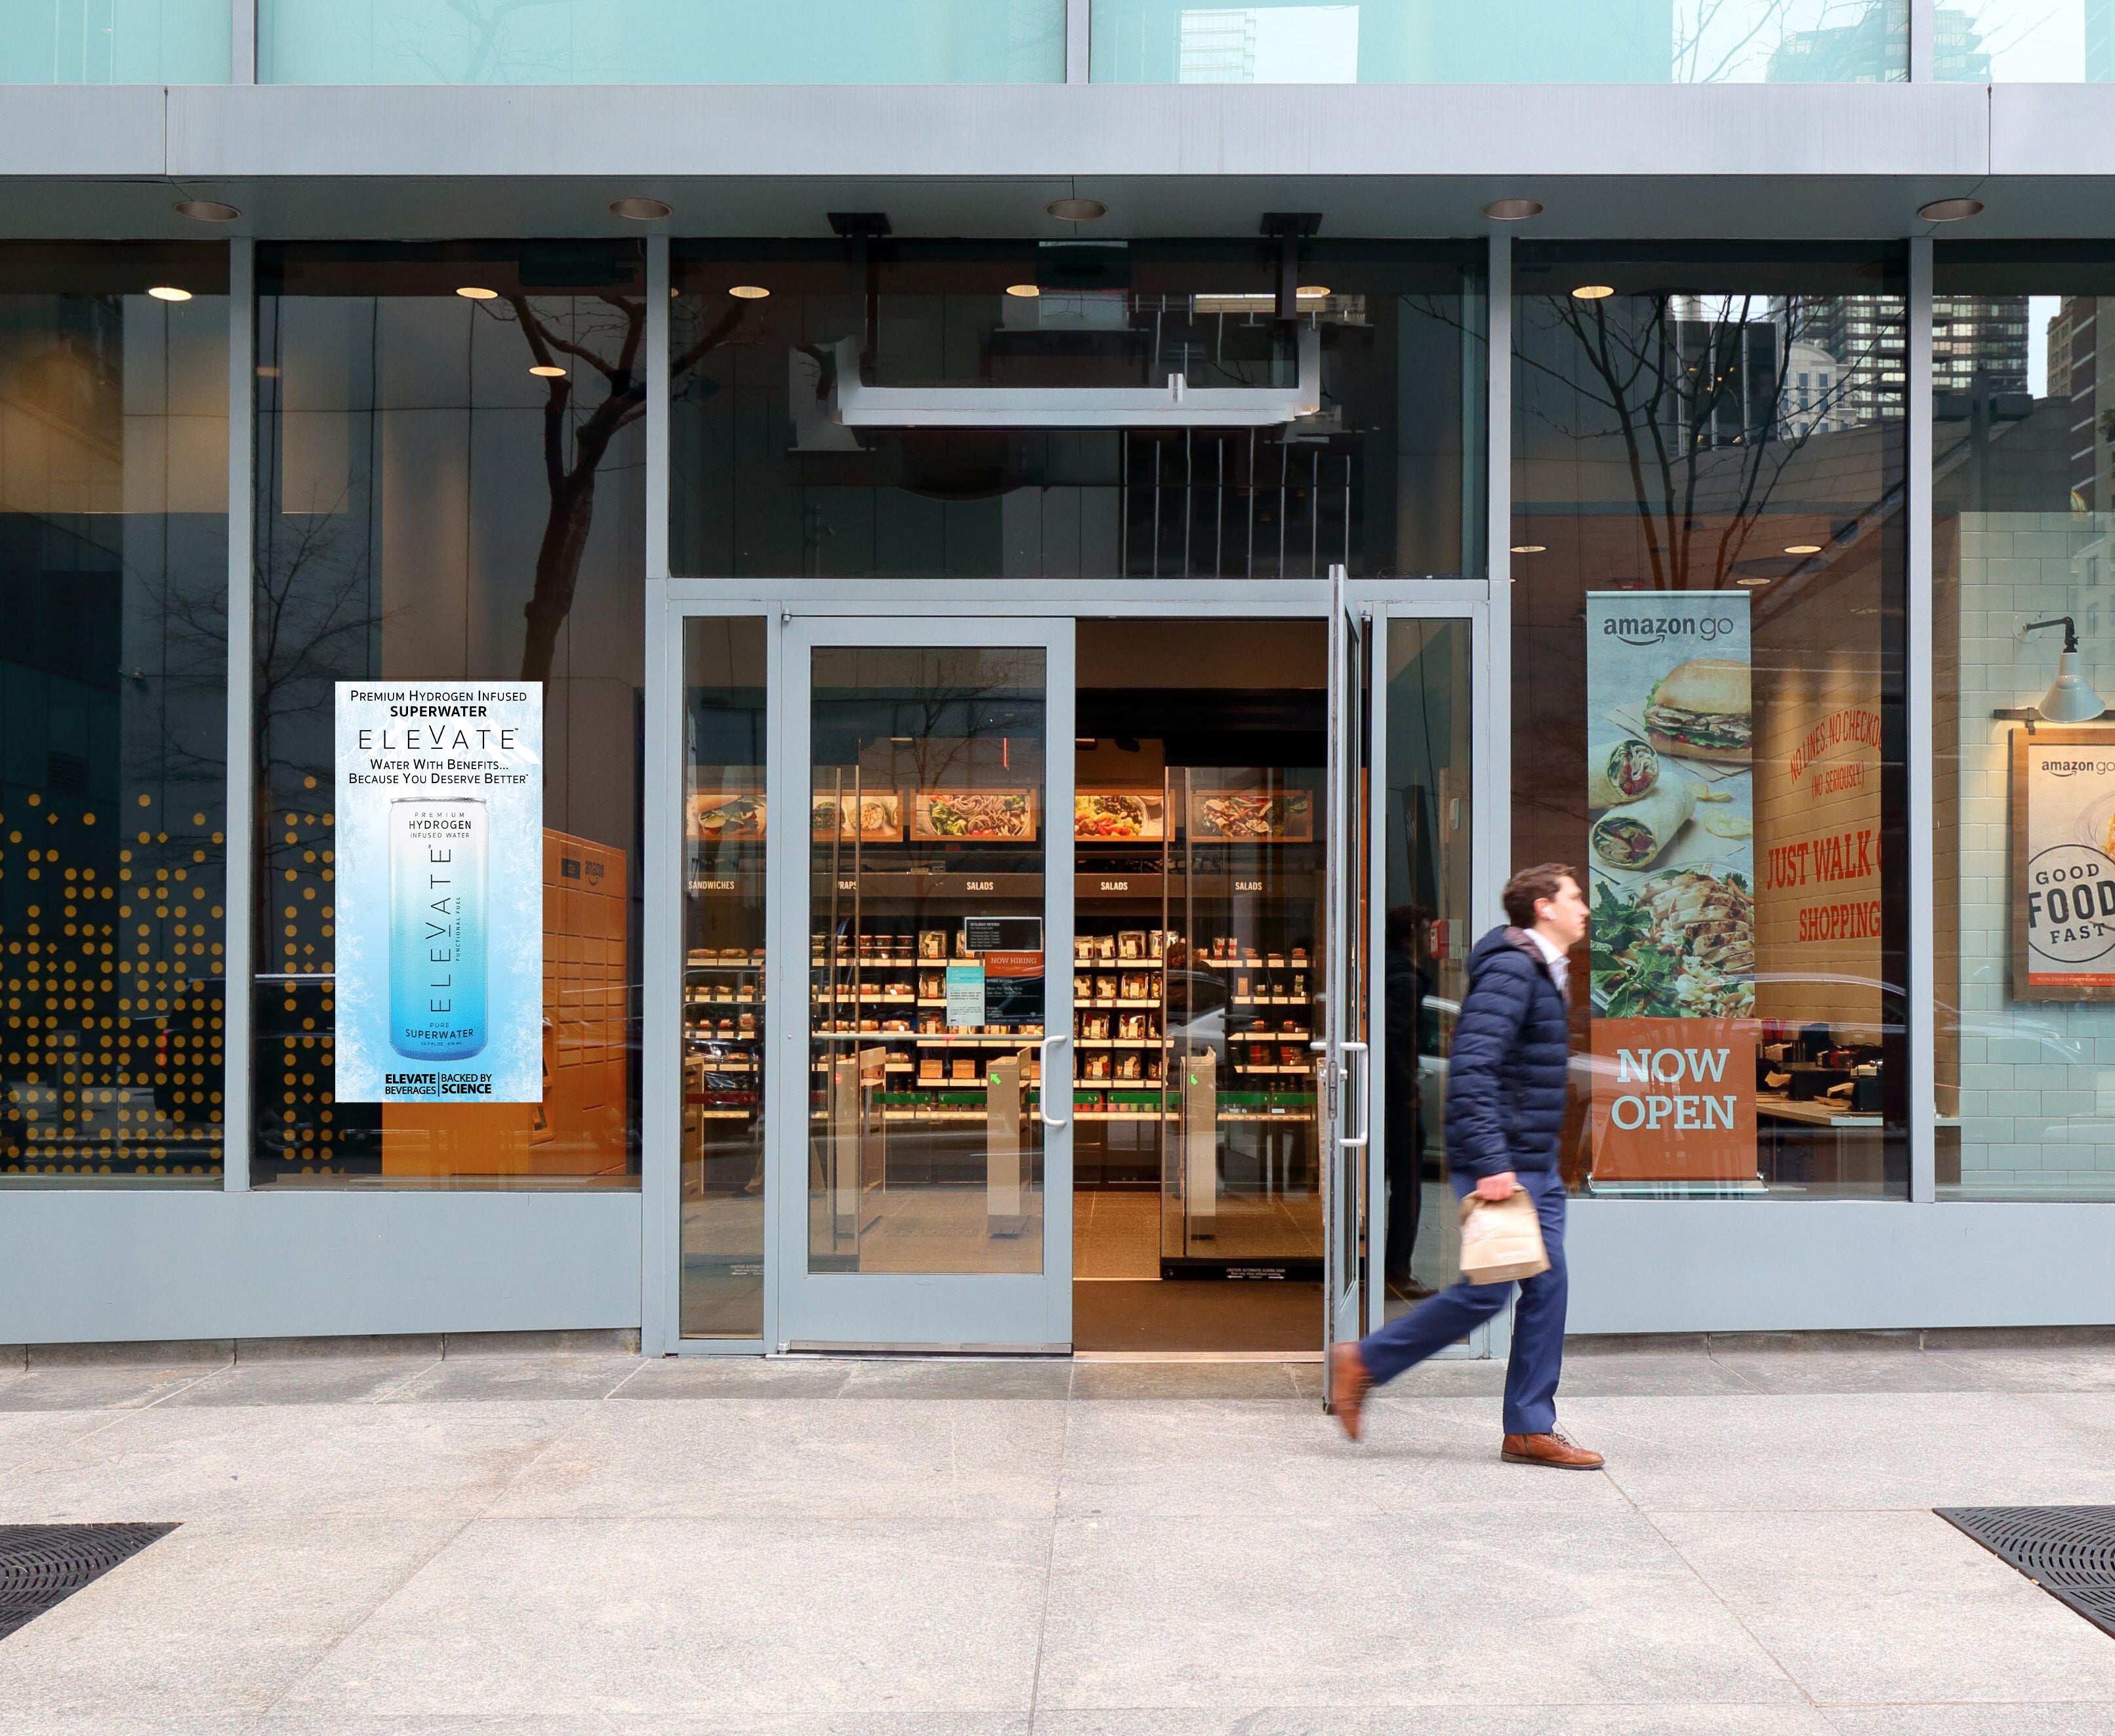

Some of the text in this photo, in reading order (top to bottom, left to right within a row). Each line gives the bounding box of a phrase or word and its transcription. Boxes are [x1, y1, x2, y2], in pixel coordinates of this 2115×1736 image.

[1603, 618, 1733, 641] amazon go
[351, 691, 527, 701] PREMIUM HYDROGEN INFUSED
[390, 706, 487, 717] SUPERWATER
[1790, 748, 1802, 786] NO
[1803, 722, 1828, 769] LINES.
[1829, 713, 1841, 746] NO
[371, 759, 508, 770] WATER WITH BENEFITS...
[2042, 761, 2115, 775] amazon go
[349, 773, 399, 784] BECAUSE
[403, 773, 426, 784] YOU
[431, 773, 480, 784] DESERVE
[409, 820, 471, 829] HYDROGEN
[1767, 842, 1809, 890] JUST
[1813, 830, 1872, 883] WALK
[2036, 863, 2099, 885] GOOD
[688, 881, 735, 890] SANDWICHES
[966, 881, 994, 891] SALADS
[1101, 881, 1128, 891] SALADS
[1235, 881, 1263, 891] SALADS
[1799, 900, 1881, 942] SHOPPING
[2050, 923, 2105, 944] FAST
[405, 1028, 474, 1039] SUPERWATER
[1617, 1048, 1731, 1083] NOW
[385, 1074, 436, 1084] ELEVATE
[441, 1074, 492, 1082] BACKED BY
[385, 1086, 436, 1095] BEVERAGES
[441, 1083, 491, 1094] SCIENCE
[1611, 1095, 1737, 1130] OPEN
